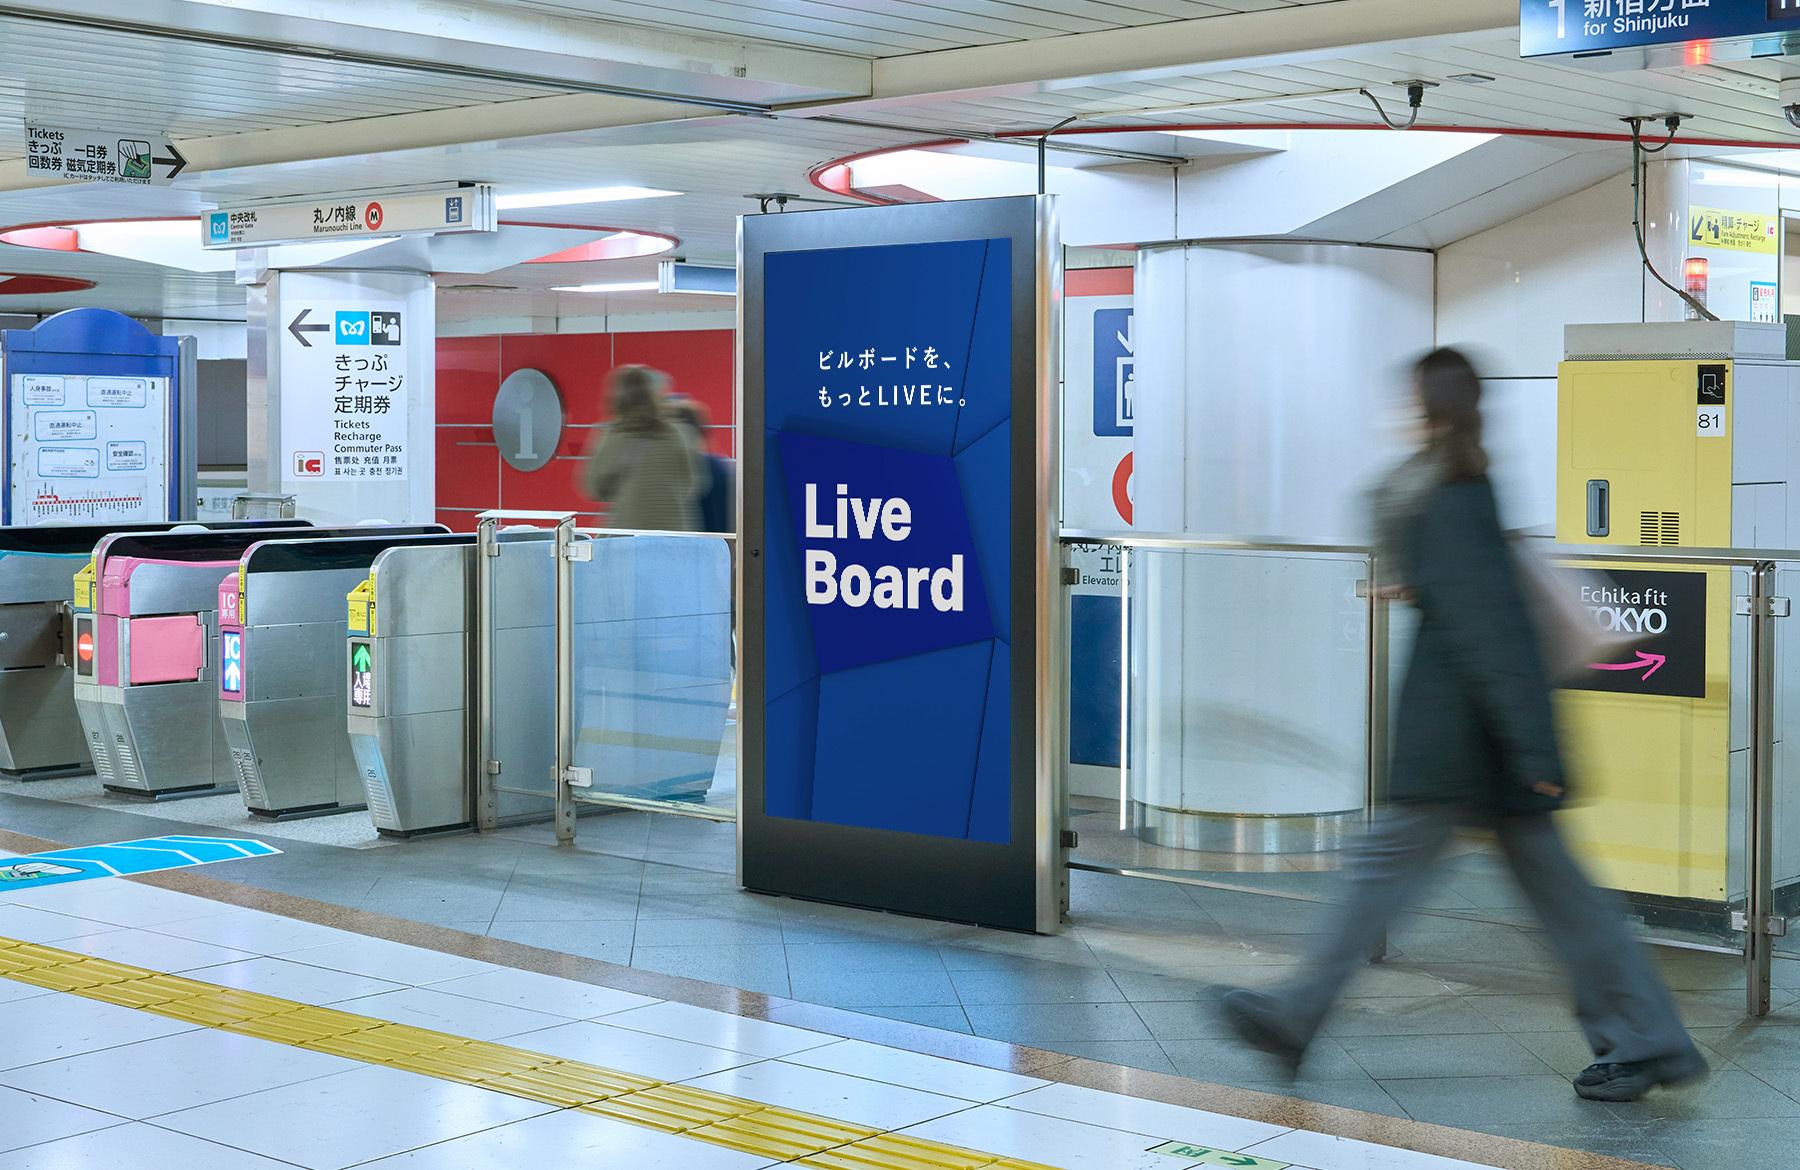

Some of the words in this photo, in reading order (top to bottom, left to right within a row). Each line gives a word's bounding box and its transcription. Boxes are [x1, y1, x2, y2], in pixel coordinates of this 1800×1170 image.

[1584, 21, 1607, 36] for
[1613, 13, 1689, 33] Shinjuku
[28, 128, 64, 140] Tickets
[28, 140, 62, 155] きっぷ
[74, 144, 107, 159] 一日券
[28, 155, 62, 171] 回数券
[66, 158, 116, 175] 磁気定期券
[313, 205, 356, 223] 丸ノ内線
[313, 223, 348, 232] Marunouchi
[350, 222, 362, 230] Line
[335, 354, 388, 371] きっぷ
[819, 347, 951, 370] ビルボードを、
[335, 375, 403, 392] チャージ
[334, 395, 391, 414] 定期券
[818, 384, 966, 408] もっとLIVEに。
[334, 420, 370, 429] Tickets
[1698, 414, 1719, 429] 81
[334, 432, 382, 443] Recharge
[334, 444, 383, 453] Commuter
[385, 444, 402, 453] Pass
[805, 483, 912, 541] Live
[805, 549, 964, 612] Board
[1082, 575, 1119, 586] Elevator
[222, 592, 236, 609] IC
[1581, 586, 1640, 605] Echika
[1644, 588, 1668, 606] fit
[224, 636, 240, 659] IC
